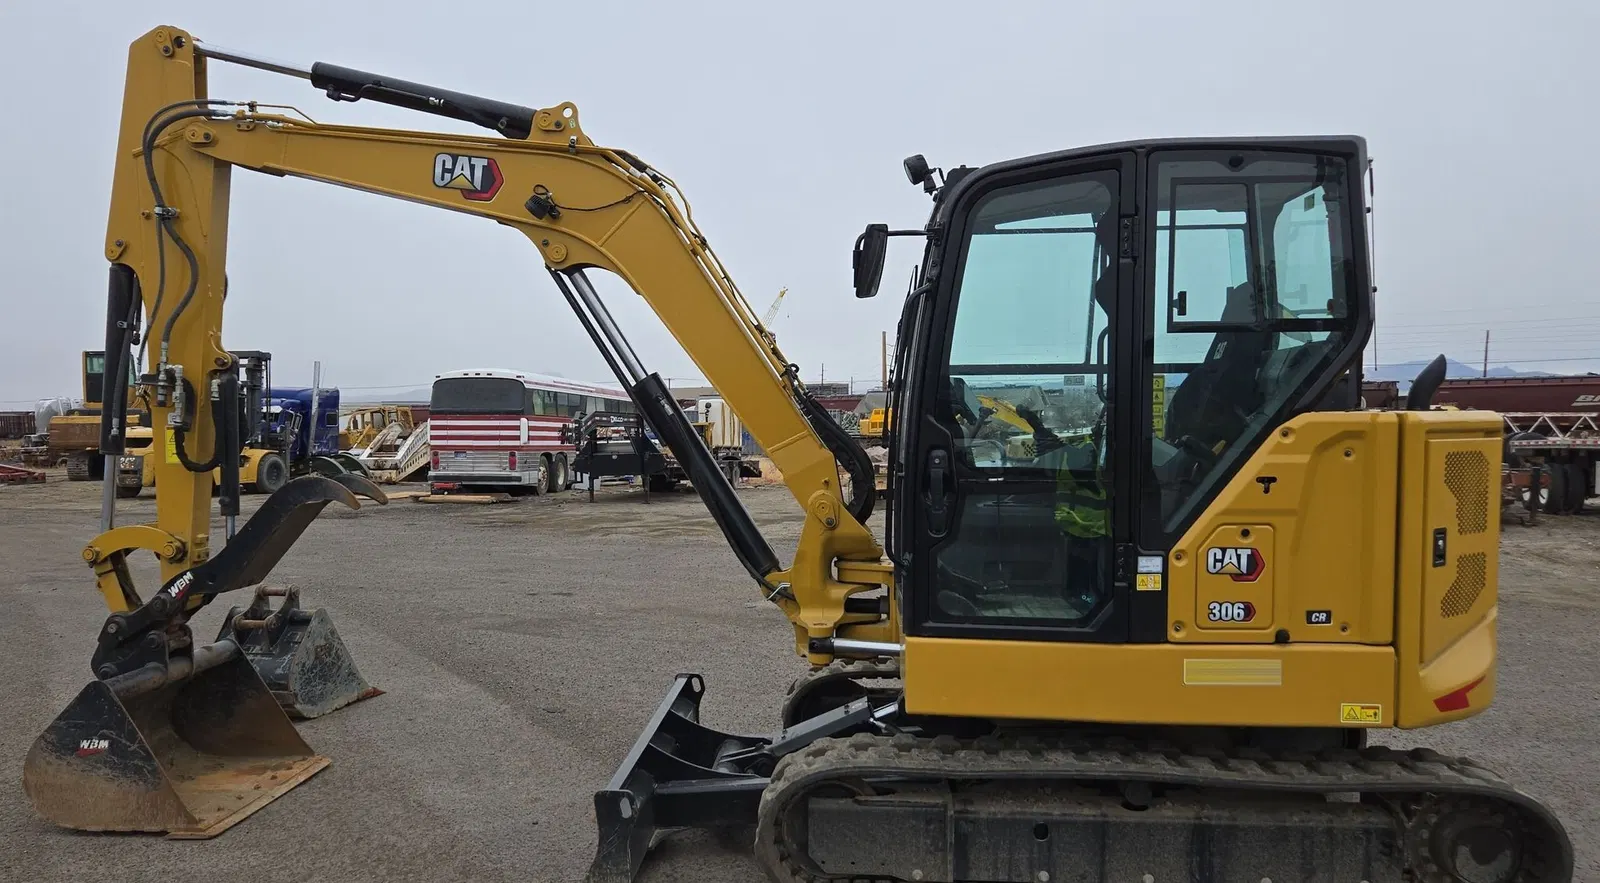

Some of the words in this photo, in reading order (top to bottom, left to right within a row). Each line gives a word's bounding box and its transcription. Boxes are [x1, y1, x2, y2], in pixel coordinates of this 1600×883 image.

[434, 153, 488, 190] CAT
[1208, 548, 1252, 573] CAT
[168, 571, 195, 598] WBM
[1208, 602, 1246, 622] 306
[1312, 612, 1327, 622] CR
[79, 739, 111, 750] WBM
